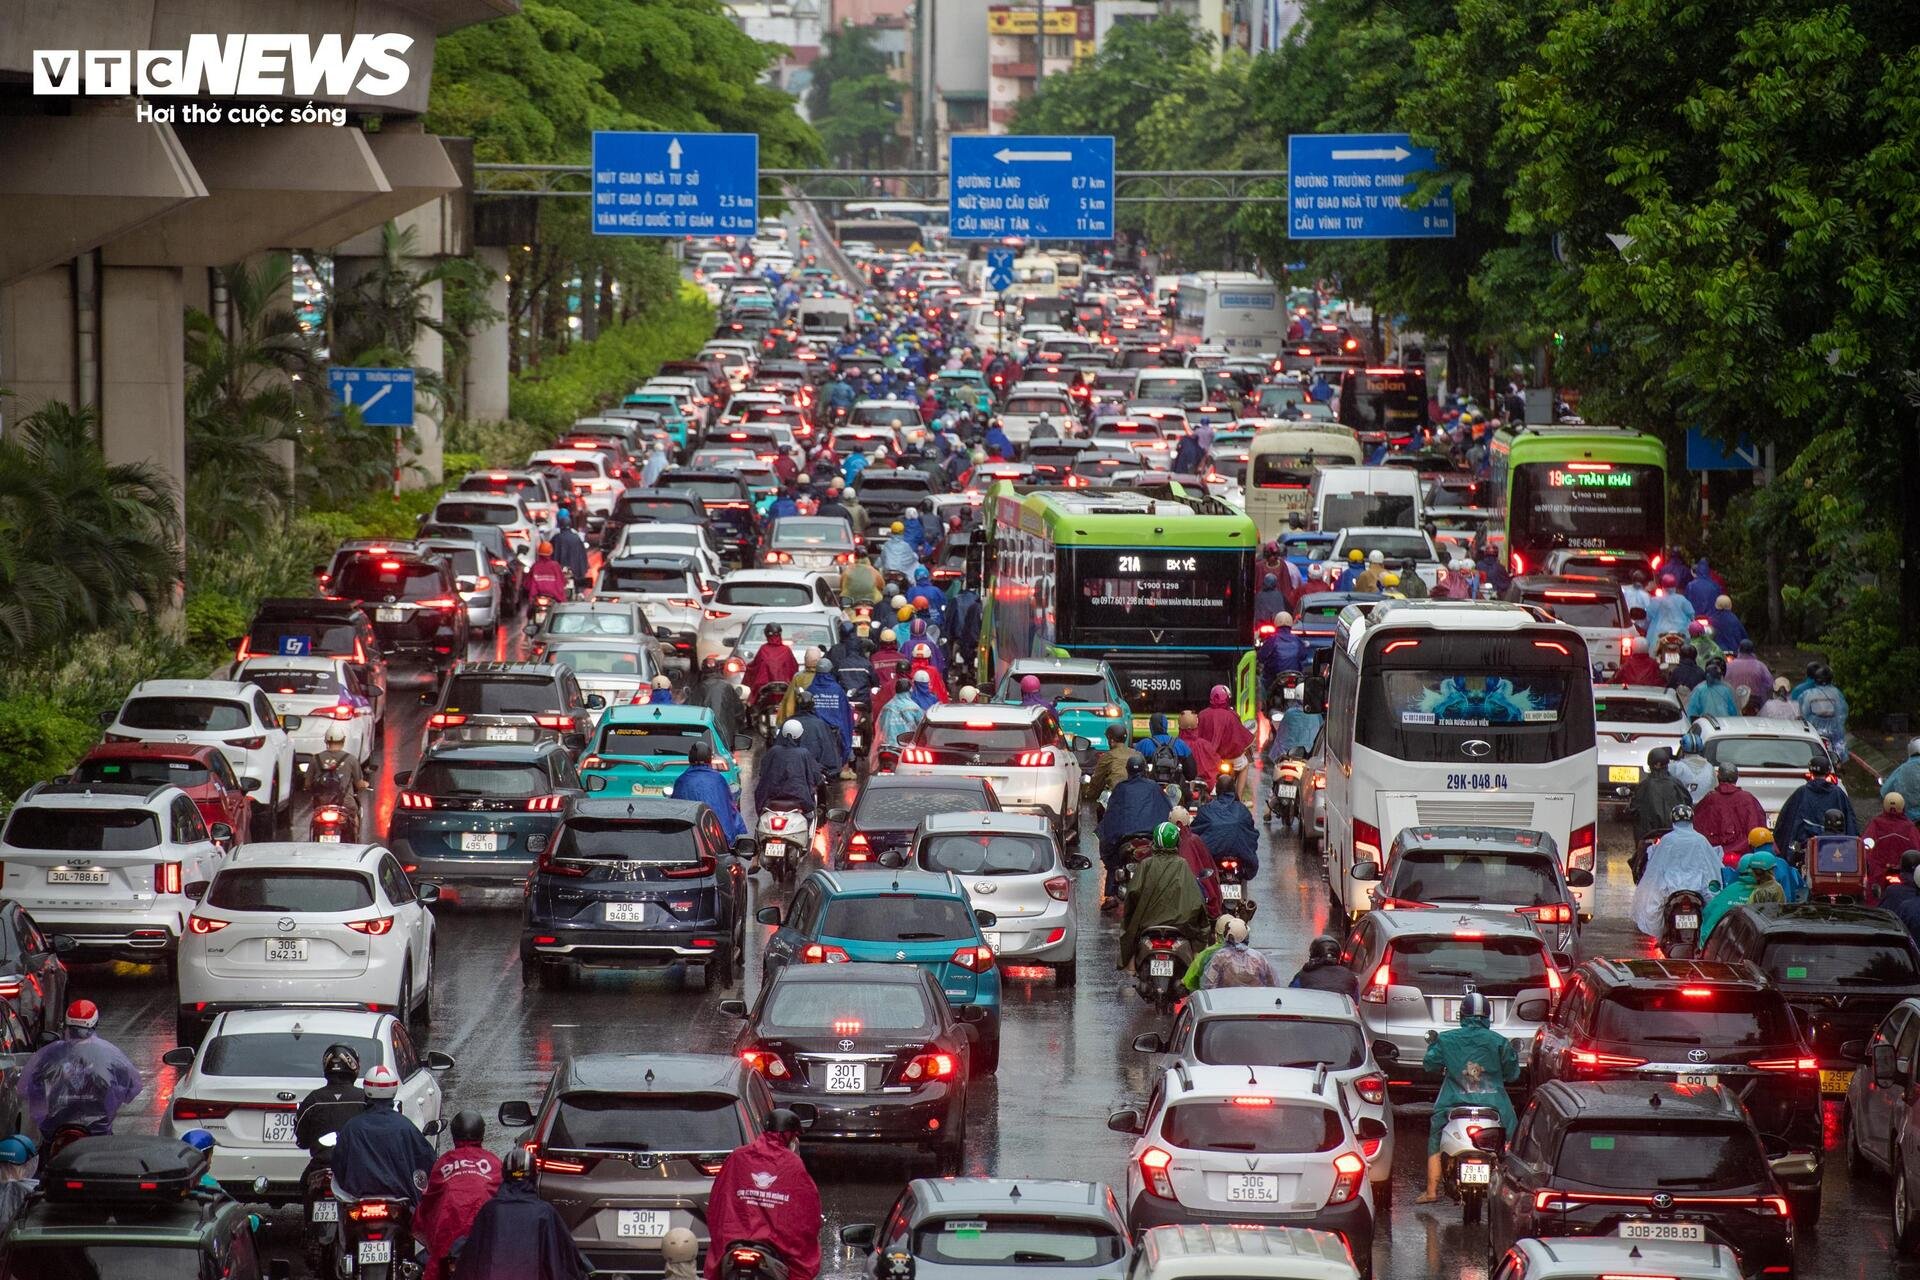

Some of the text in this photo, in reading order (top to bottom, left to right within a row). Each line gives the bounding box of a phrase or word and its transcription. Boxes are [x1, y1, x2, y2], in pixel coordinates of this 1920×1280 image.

[597, 170, 616, 184] NÚT
[619, 172, 642, 185] GIAO
[957, 174, 991, 189] ĐƯỜNG
[1090, 177, 1105, 189] km
[1295, 172, 1328, 188] ĐƯỜNG
[1332, 171, 1371, 188] TRƯỜNG
[597, 190, 616, 205] NÚT
[619, 193, 642, 205] GIAO
[719, 196, 735, 208] 2.5
[737, 196, 754, 208] km
[980, 197, 1003, 209] GIAO
[1080, 198, 1087, 209] 5
[1090, 198, 1105, 209] km
[1295, 193, 1314, 209] NÚT
[1317, 195, 1339, 209] GIAO
[1382, 195, 1407, 211] VỌN
[619, 210, 643, 226] MIẾU
[645, 211, 671, 227] QUỐC
[689, 212, 714, 227] GIÁM
[720, 216, 735, 228] 4.3
[737, 216, 754, 228] km
[1077, 218, 1087, 230] 11
[1090, 218, 1105, 230] km
[1433, 218, 1449, 229] km
[1578, 471, 1604, 486] TRẦN
[1119, 556, 1141, 572] 21A
[1166, 559, 1181, 571] BX
[1143, 582, 1180, 590] 1900 1298
[1131, 679, 1182, 691] 29E-559.05
[1447, 774, 1508, 790] 29K-048.04
[53, 871, 104, 882] 30L-788.61
[617, 904, 633, 912] 30G
[610, 912, 639, 920] 948.36
[278, 941, 296, 949] 30G
[271, 951, 303, 959] 942.31
[835, 1065, 857, 1077] 30T
[1830, 1072, 1848, 1081] 29E
[831, 1078, 861, 1089] 2545
[1242, 1177, 1263, 1187] 30G
[1233, 1188, 1272, 1200] 518.54
[633, 1212, 656, 1223] 30H
[623, 1224, 664, 1235] 919.17
[1627, 1226, 1697, 1239] 30B-288.83
[363, 1243, 385, 1252] 29-C1
[361, 1253, 388, 1262] 756.08
